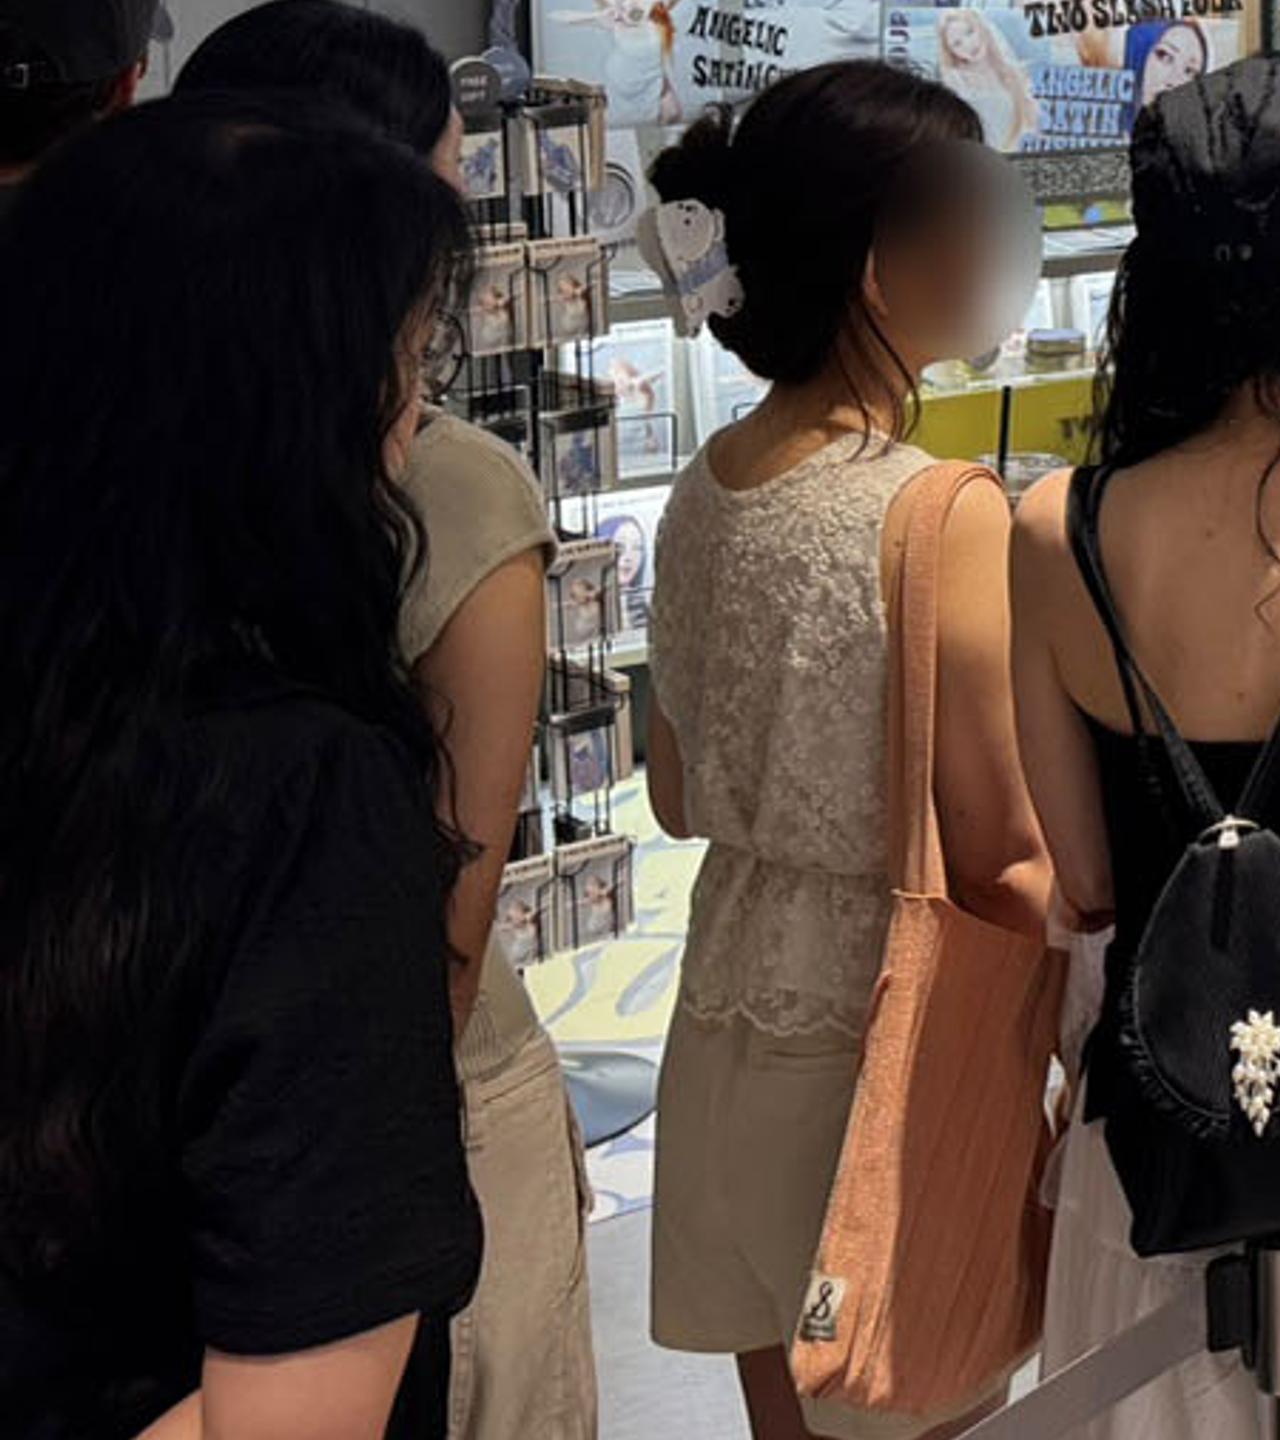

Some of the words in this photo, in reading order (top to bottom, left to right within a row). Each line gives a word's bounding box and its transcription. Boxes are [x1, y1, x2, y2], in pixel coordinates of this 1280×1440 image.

[688, 6, 788, 57] ANGELIC
[1032, 68, 1136, 102] ANGELIC
[1039, 101, 1121, 134] SATIN
